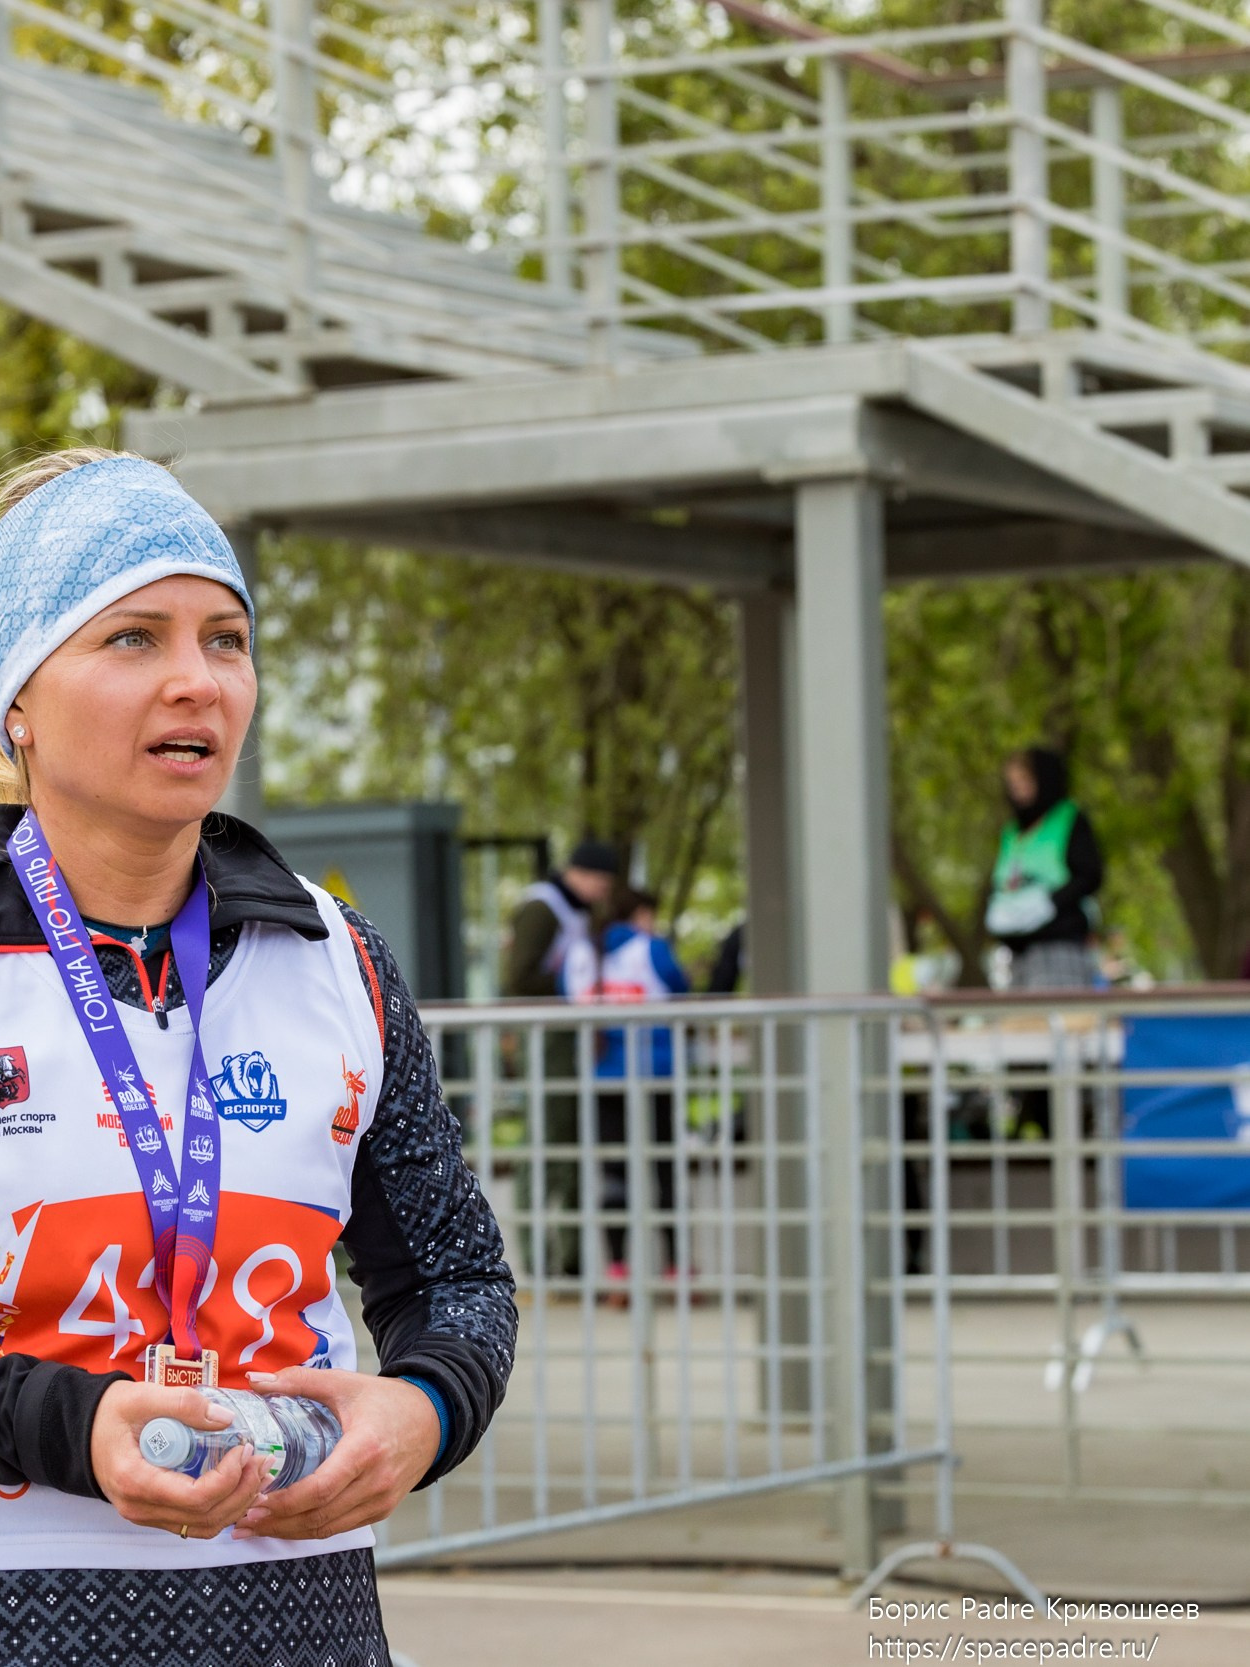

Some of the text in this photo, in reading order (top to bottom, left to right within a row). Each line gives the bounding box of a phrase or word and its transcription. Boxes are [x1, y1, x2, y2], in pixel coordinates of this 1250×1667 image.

[25, 857, 62, 904] ПУТЬ
[47, 908, 82, 951] ГТО
[66, 955, 114, 1033] ГОНКА
[122, 1101, 149, 1112] ПОБЕДА!
[223, 1104, 282, 1115] ВСПОРТЕ
[20, 1113, 56, 1123] спорта
[190, 1108, 214, 1121] ПОБЕДА!
[2, 1125, 43, 1137] Москвы
